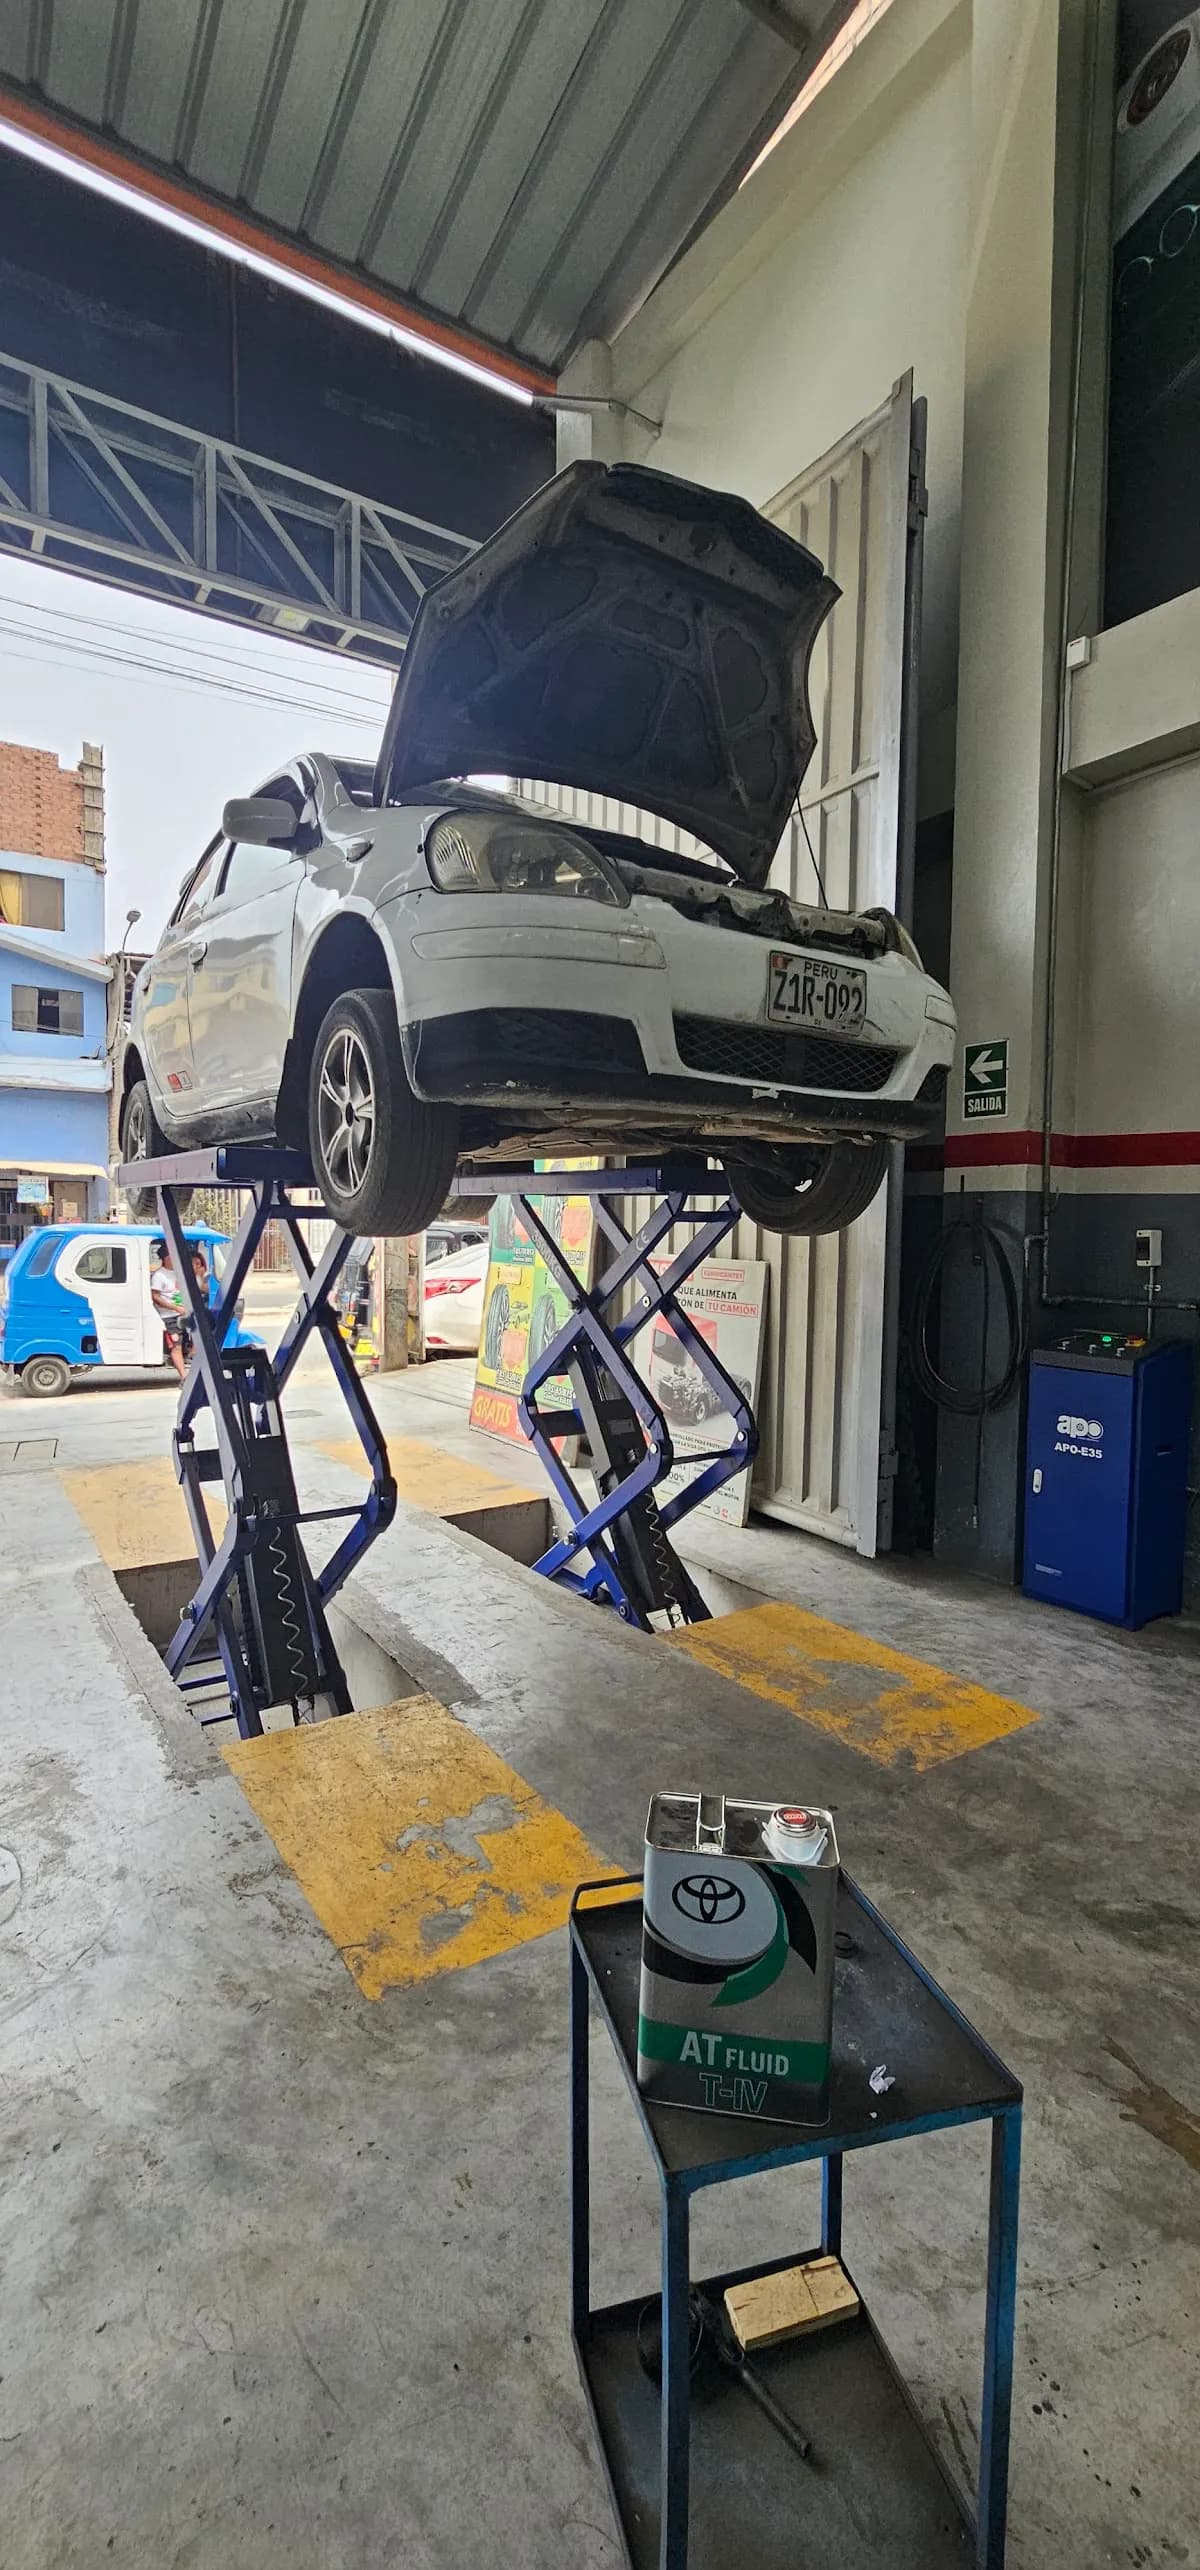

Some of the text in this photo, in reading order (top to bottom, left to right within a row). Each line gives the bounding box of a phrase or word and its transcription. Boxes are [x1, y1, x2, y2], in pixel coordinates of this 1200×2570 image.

[803, 961, 838, 980] PERU
[773, 970, 863, 1025] Z1R-092
[967, 1096, 1002, 1113] SALIDA
[678, 1286, 737, 1300] QUE ALIMENTA
[694, 1300, 705, 1309] DE
[708, 1301, 718, 1311] TU
[719, 1303, 757, 1316] CAMIÓN
[474, 1395, 512, 1428] GRATIS
[1057, 1415, 1104, 1439] apo
[1054, 1442, 1103, 1459] APO-E35
[680, 2031, 789, 2075] AT FLUID
[699, 2072, 768, 2113] T-IV
